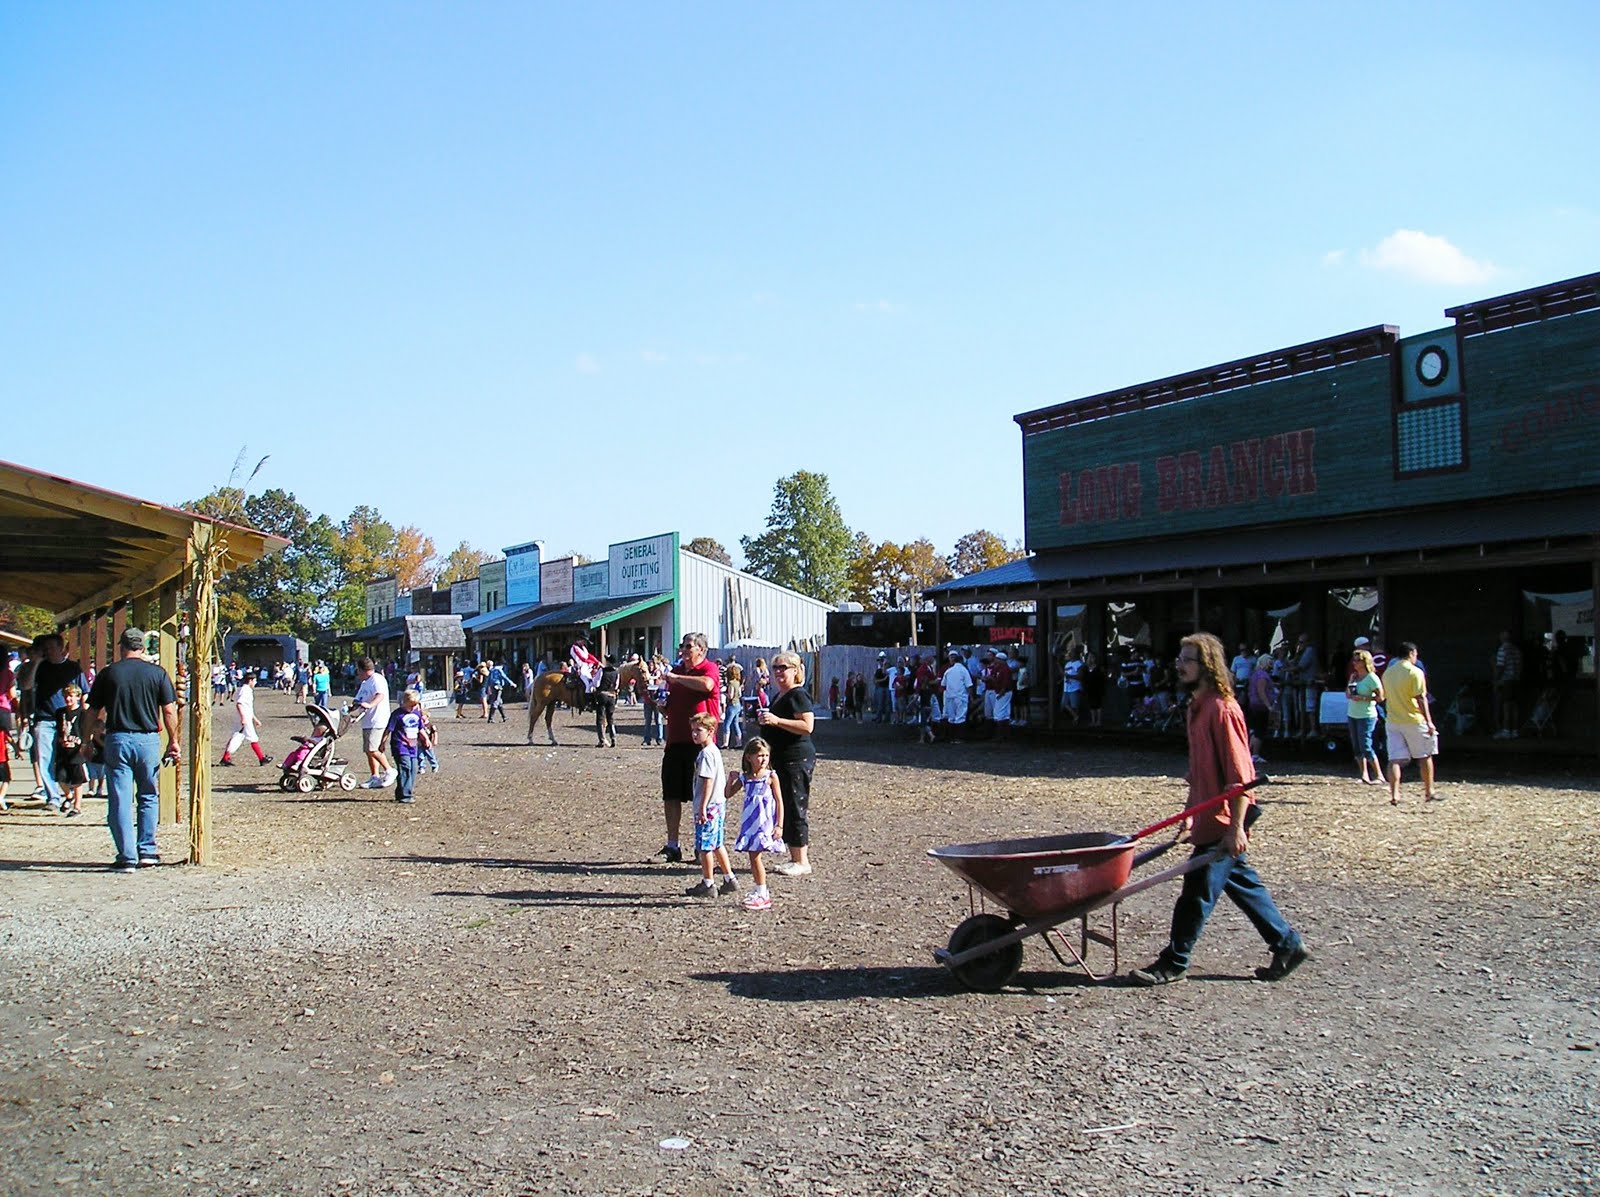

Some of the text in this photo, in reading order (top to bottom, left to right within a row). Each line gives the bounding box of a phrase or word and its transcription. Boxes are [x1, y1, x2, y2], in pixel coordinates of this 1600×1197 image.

[1060, 427, 1317, 526] LONG BRANCH
[624, 543, 656, 560] GENERAL
[621, 561, 660, 579] OUTFITTING
[632, 578, 648, 590] STORE
